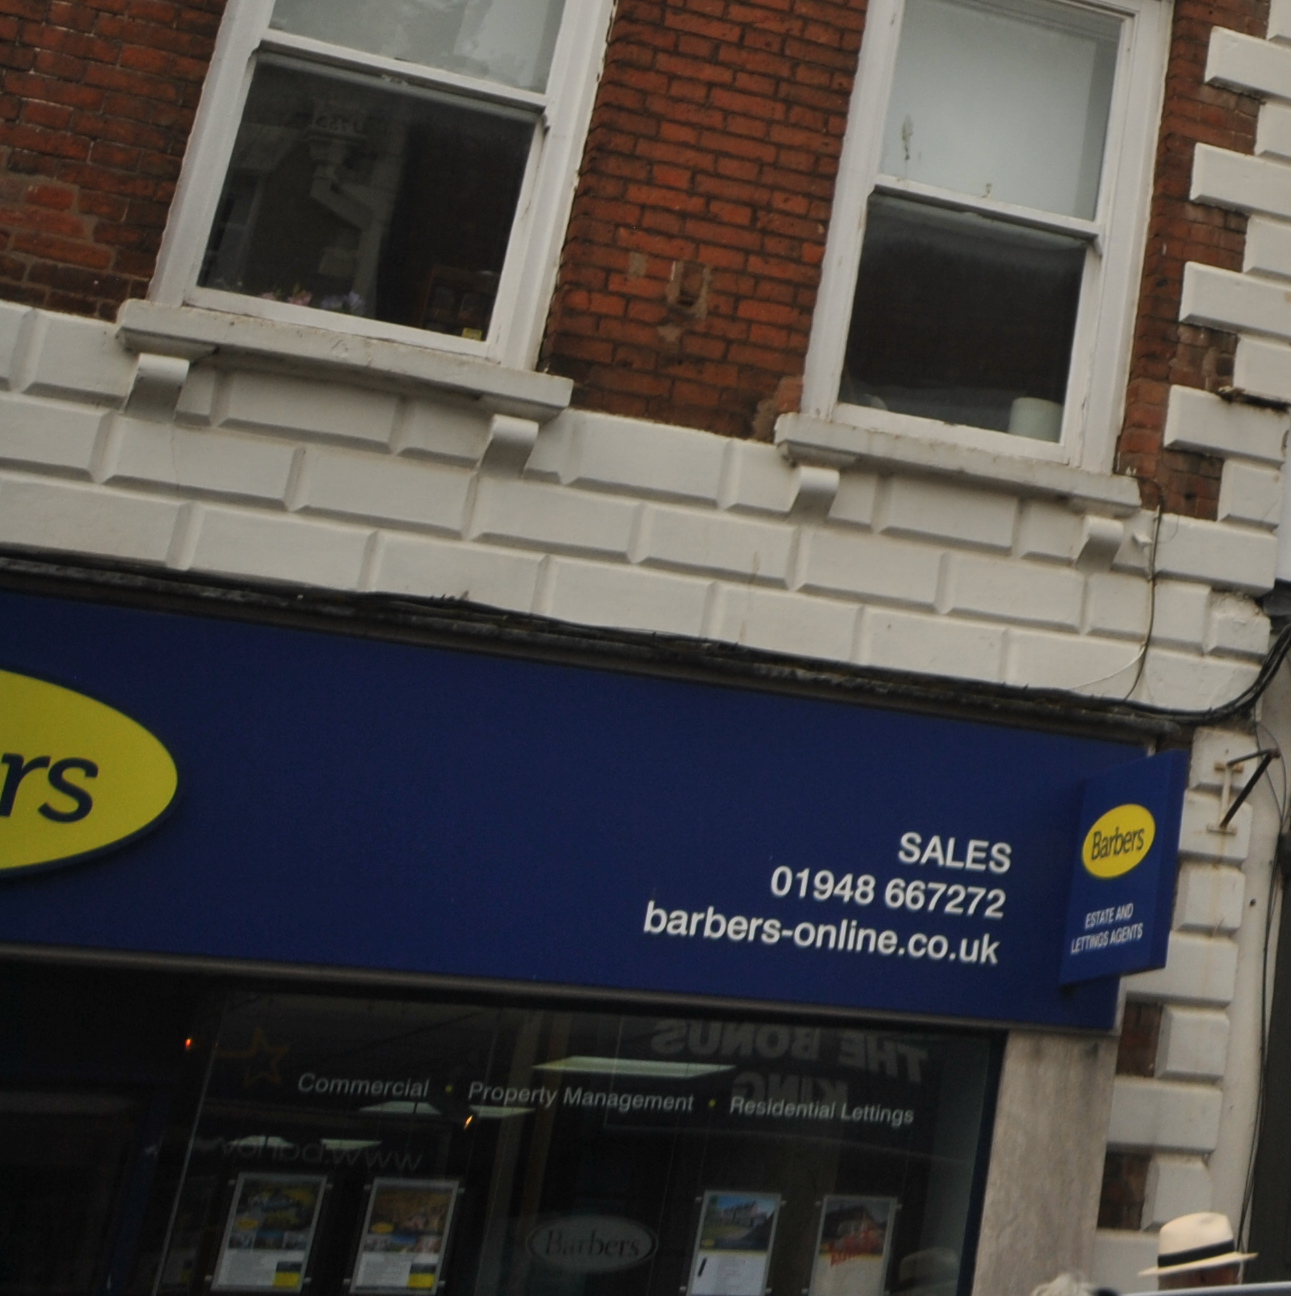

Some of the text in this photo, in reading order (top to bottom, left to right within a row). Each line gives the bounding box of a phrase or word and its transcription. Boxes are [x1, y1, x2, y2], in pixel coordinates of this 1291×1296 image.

[899, 832, 1011, 873] SALES
[1091, 827, 1145, 861] Barbers
[771, 866, 1006, 919] 01948 667272
[643, 900, 999, 965] barbers-online.co.uk
[1085, 903, 1134, 930] ESTATE AND
[1070, 923, 1144, 955] LETTINGS AGENTS
[297, 1072, 915, 1126] Commercial Property Management Residential Lettings
[545, 1229, 641, 1258] Barbers
